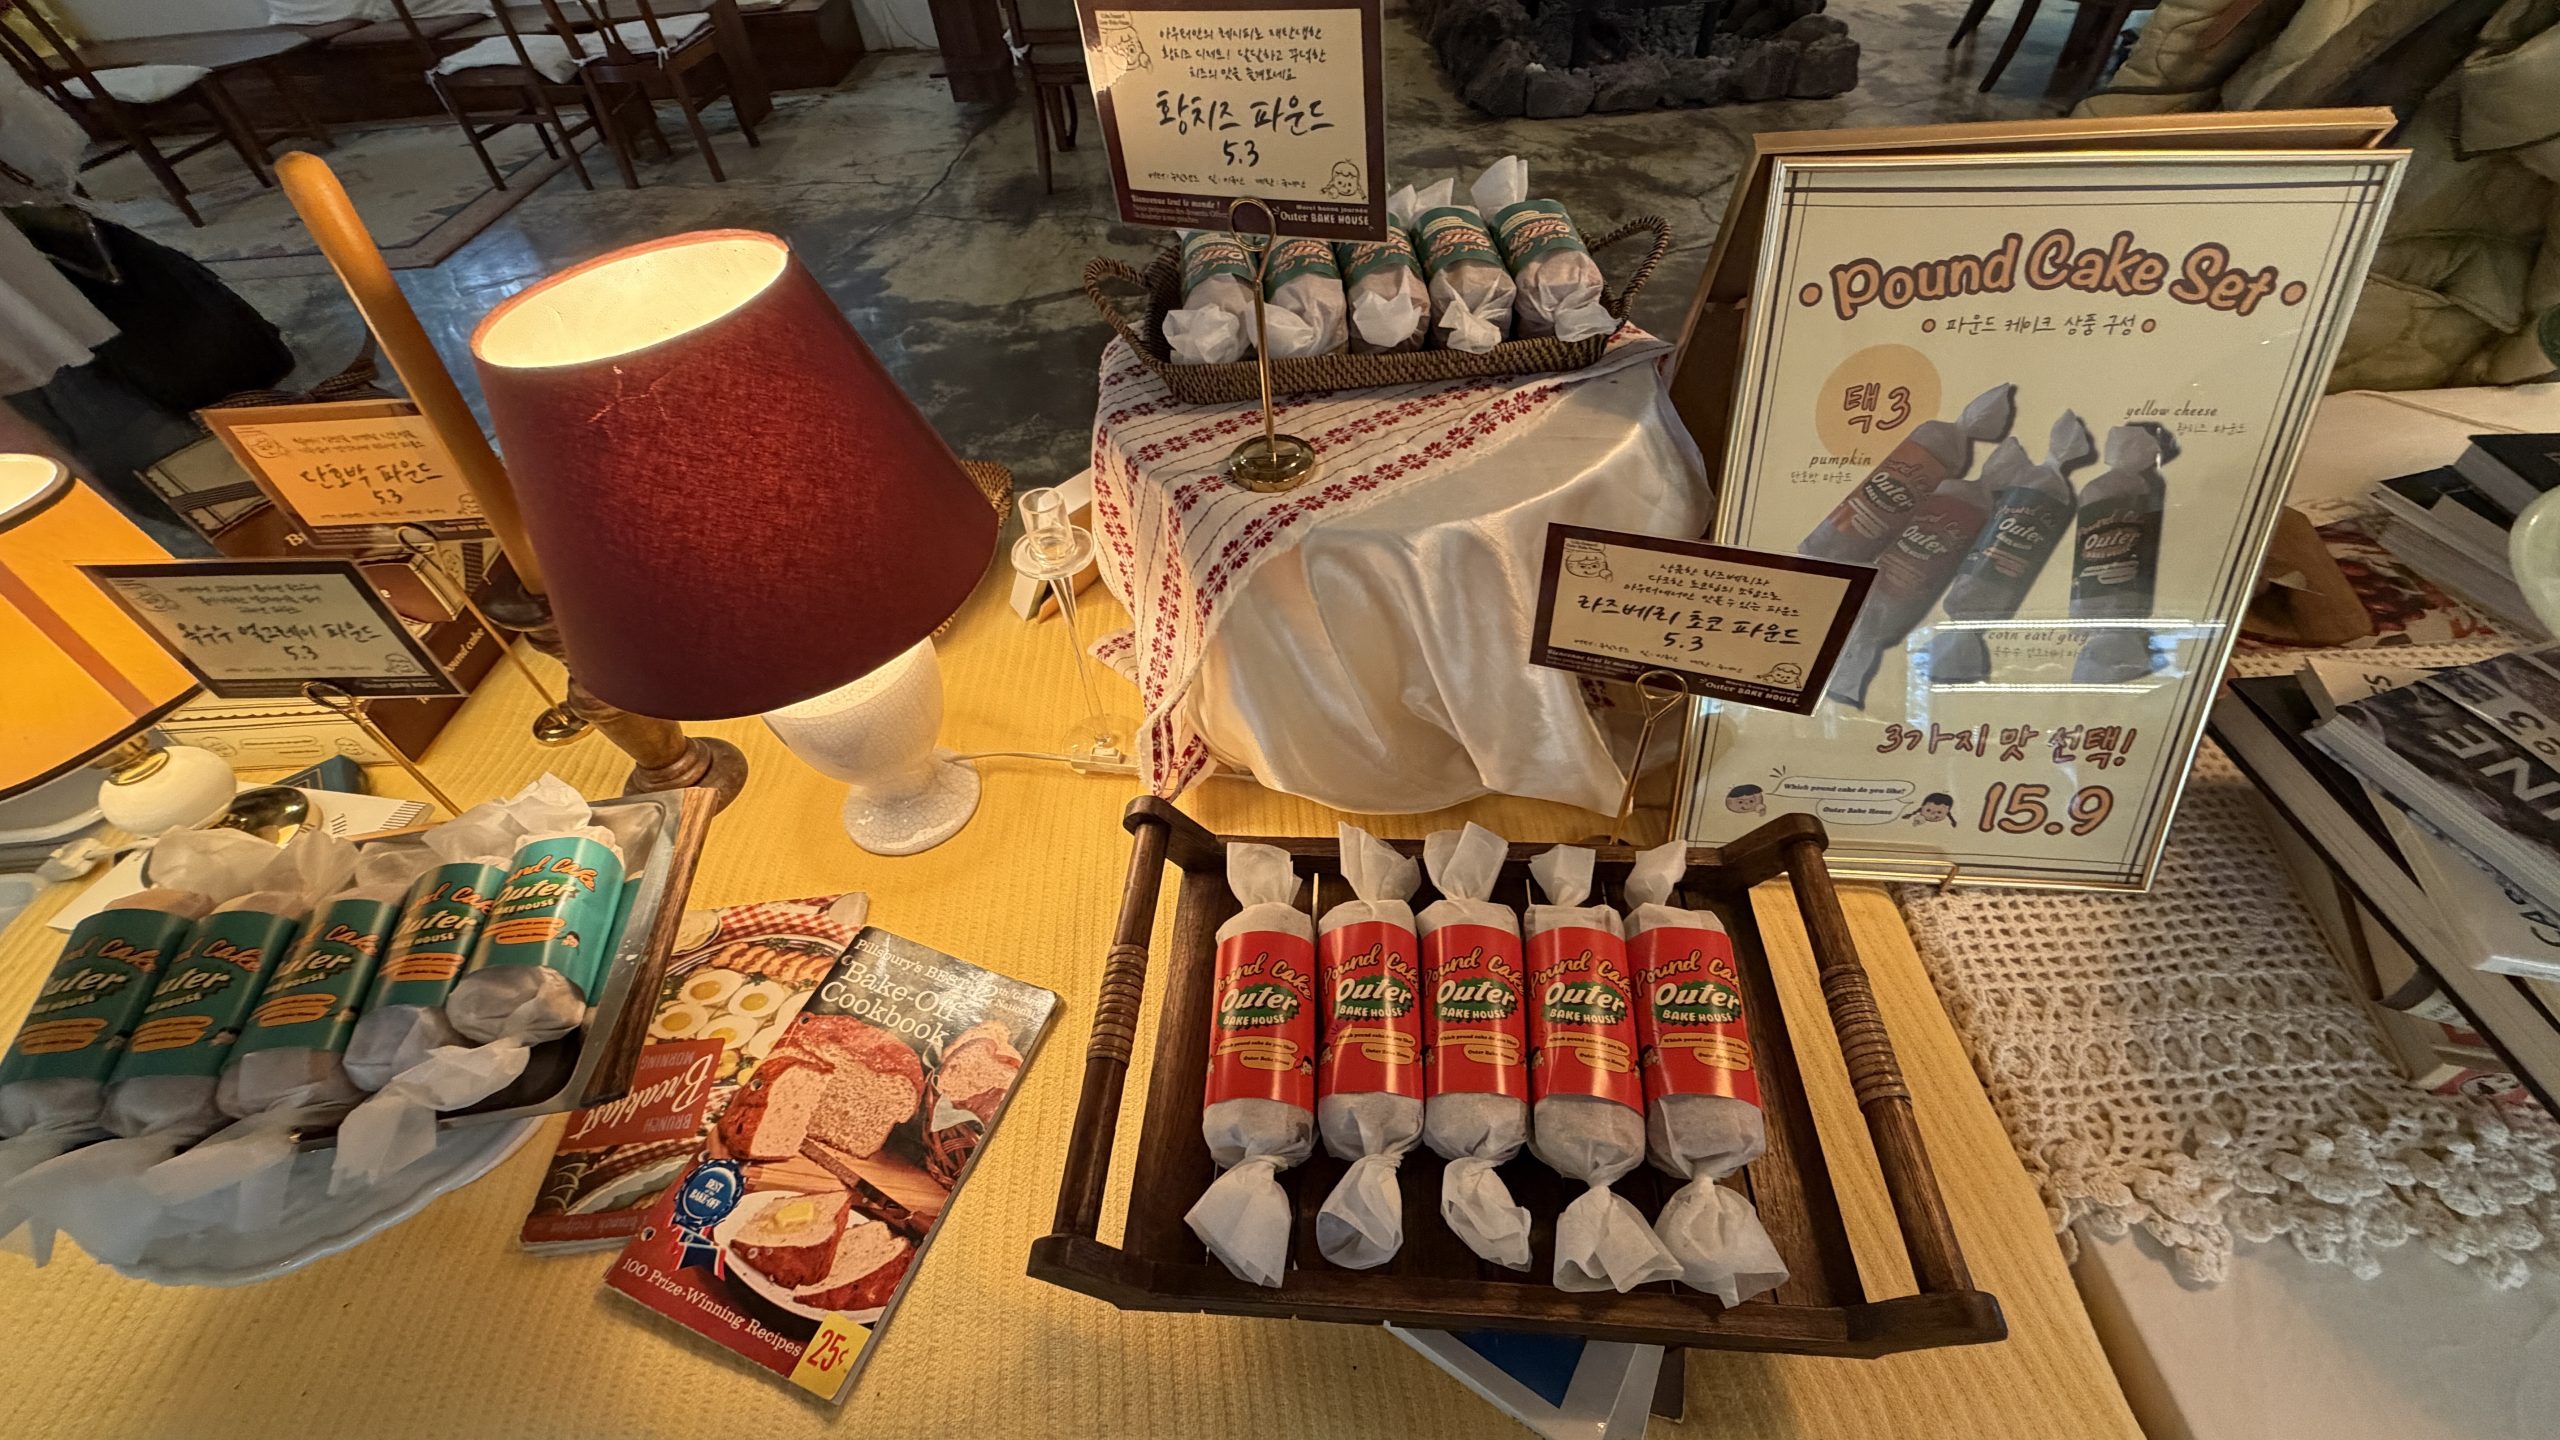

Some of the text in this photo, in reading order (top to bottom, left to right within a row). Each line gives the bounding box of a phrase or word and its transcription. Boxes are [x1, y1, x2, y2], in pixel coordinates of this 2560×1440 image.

[1162, 45, 1192, 61] 황치즈
[1189, 67, 1217, 80] 치즈의
[1157, 91, 1334, 136] 황치즈 파운드
[1224, 140, 1259, 167] 5.3
[1280, 211, 1369, 226] Outer BAKE HOUSE
[1831, 228, 2278, 320] Pound Cake Set
[1945, 314, 2136, 335] 파운드 케이크 상품 구성
[2123, 400, 2218, 419] yellow cheese
[1809, 448, 1872, 468] pumpkin
[300, 460, 443, 488] 단호박 파운드
[373, 489, 402, 504] 5.3
[1999, 517, 2043, 544] Outer
[2084, 529, 2141, 550] Outer
[1578, 595, 1801, 645] 라즈베리 초코 파운드
[238, 622, 316, 643] 얼그레이
[322, 622, 383, 643] 파운드
[1663, 632, 1704, 652] 5.3
[1988, 631, 2018, 641] corn
[2025, 628, 2056, 641] earl
[284, 646, 318, 660] 5.3
[1705, 681, 1798, 704] Outer BAKE HOUSE
[1877, 723, 2137, 769] 3가지 맛 선택!
[1784, 783, 1809, 791] Which
[1822, 806, 1846, 814] Outer
[1868, 808, 1893, 816] House
[1979, 781, 2114, 836] 15.9
[516, 898, 556, 912] HOUSE
[854, 939, 923, 974] Pillsbury's
[926, 965, 970, 991] BEST
[1531, 950, 1592, 999] Pound
[1635, 949, 1702, 997] Pound
[1270, 960, 1312, 1000] Cake
[1336, 978, 1412, 1003] Outer
[840, 961, 958, 1022] Bake-Off
[1221, 988, 1298, 1014] Outer
[1437, 980, 1516, 1006] Outer
[1545, 982, 1625, 1012] Outer
[1655, 983, 1741, 1009] Outer
[820, 981, 951, 1045] Cookbook
[1223, 1014, 1285, 1026] BAKE HOUSE
[1340, 1005, 1403, 1018] BAKE HOUSE
[1441, 1006, 1507, 1019] BAKE HOUSE
[1550, 1009, 1617, 1025] BAKE HOUSE
[1662, 1009, 1734, 1022] BAKE HOUSE
[640, 1051, 696, 1069] MORNING
[568, 1053, 713, 1141] Breakfast
[643, 1113, 693, 1133] BRUNCH
[705, 1178, 725, 1193] BEST
[622, 1258, 802, 1358] 100 Prize-Winning Recipes
[806, 1328, 849, 1372] 25¢
